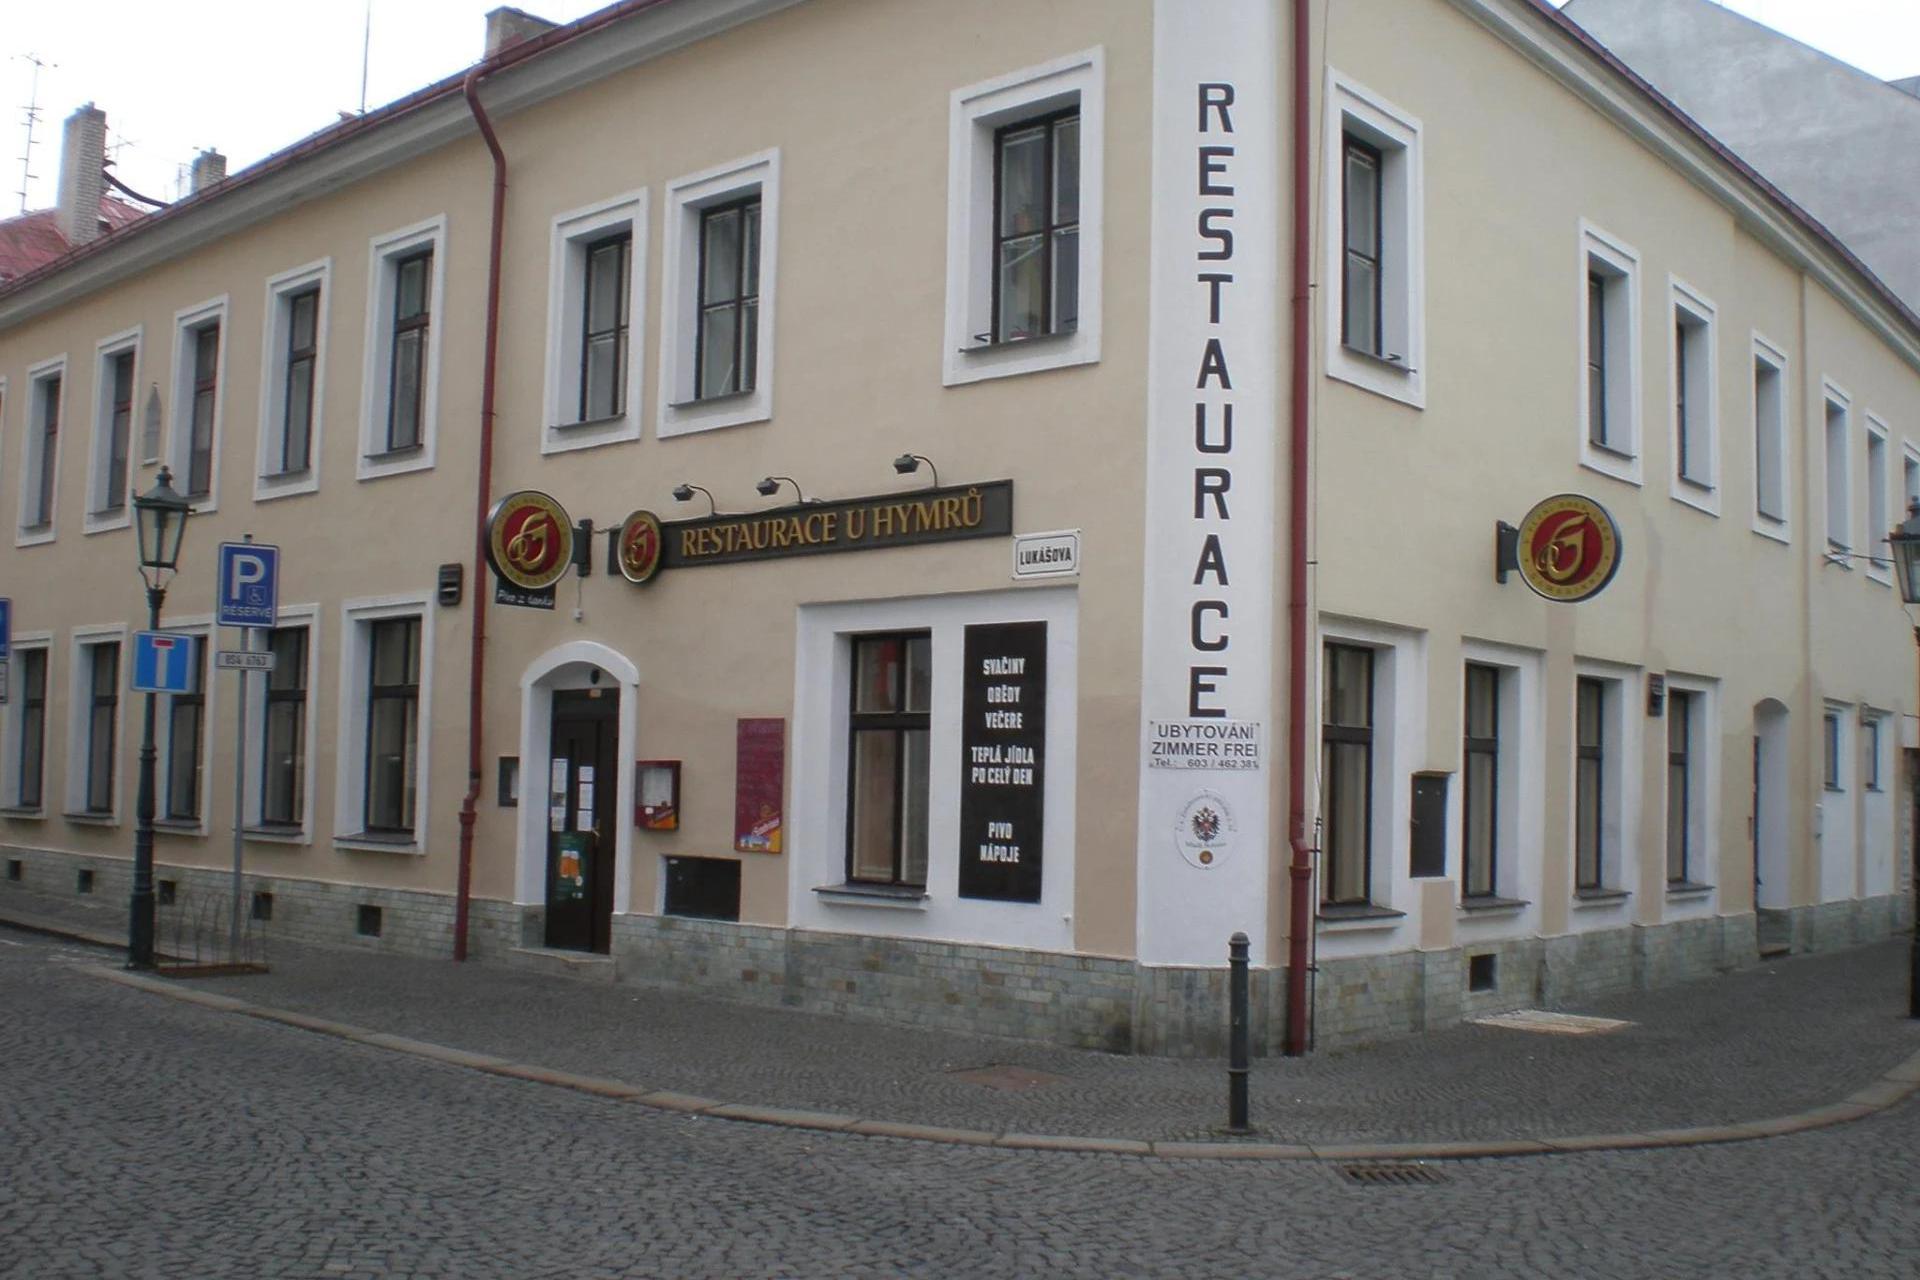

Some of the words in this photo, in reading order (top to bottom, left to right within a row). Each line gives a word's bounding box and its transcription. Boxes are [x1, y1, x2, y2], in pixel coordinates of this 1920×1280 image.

[1188, 82, 1235, 718] RESTAURACE
[681, 511, 838, 557] RESTAURACE
[846, 509, 865, 540] U
[873, 488, 984, 537] HYMRŮ
[1020, 546, 1073, 566] LUKÁŠOVA
[231, 553, 265, 600] P
[982, 656, 1026, 676] SVAČINY
[987, 684, 1021, 704] OBĚDY
[985, 709, 1023, 729] VEČERE
[1158, 722, 1254, 740] UBYTOVÁNÍ
[971, 746, 1002, 764] TEPLÁ
[1004, 745, 1035, 765] JÍDLA
[1152, 742, 1219, 757] ZIMMER
[1224, 743, 1258, 757] FREI
[1187, 759, 1208, 768] 603
[971, 767, 986, 784] PO
[987, 764, 1011, 785] CELÝ
[1013, 768, 1033, 786] DEN
[988, 821, 1013, 840] PIVO
[980, 844, 1020, 863] NÁPOJE
